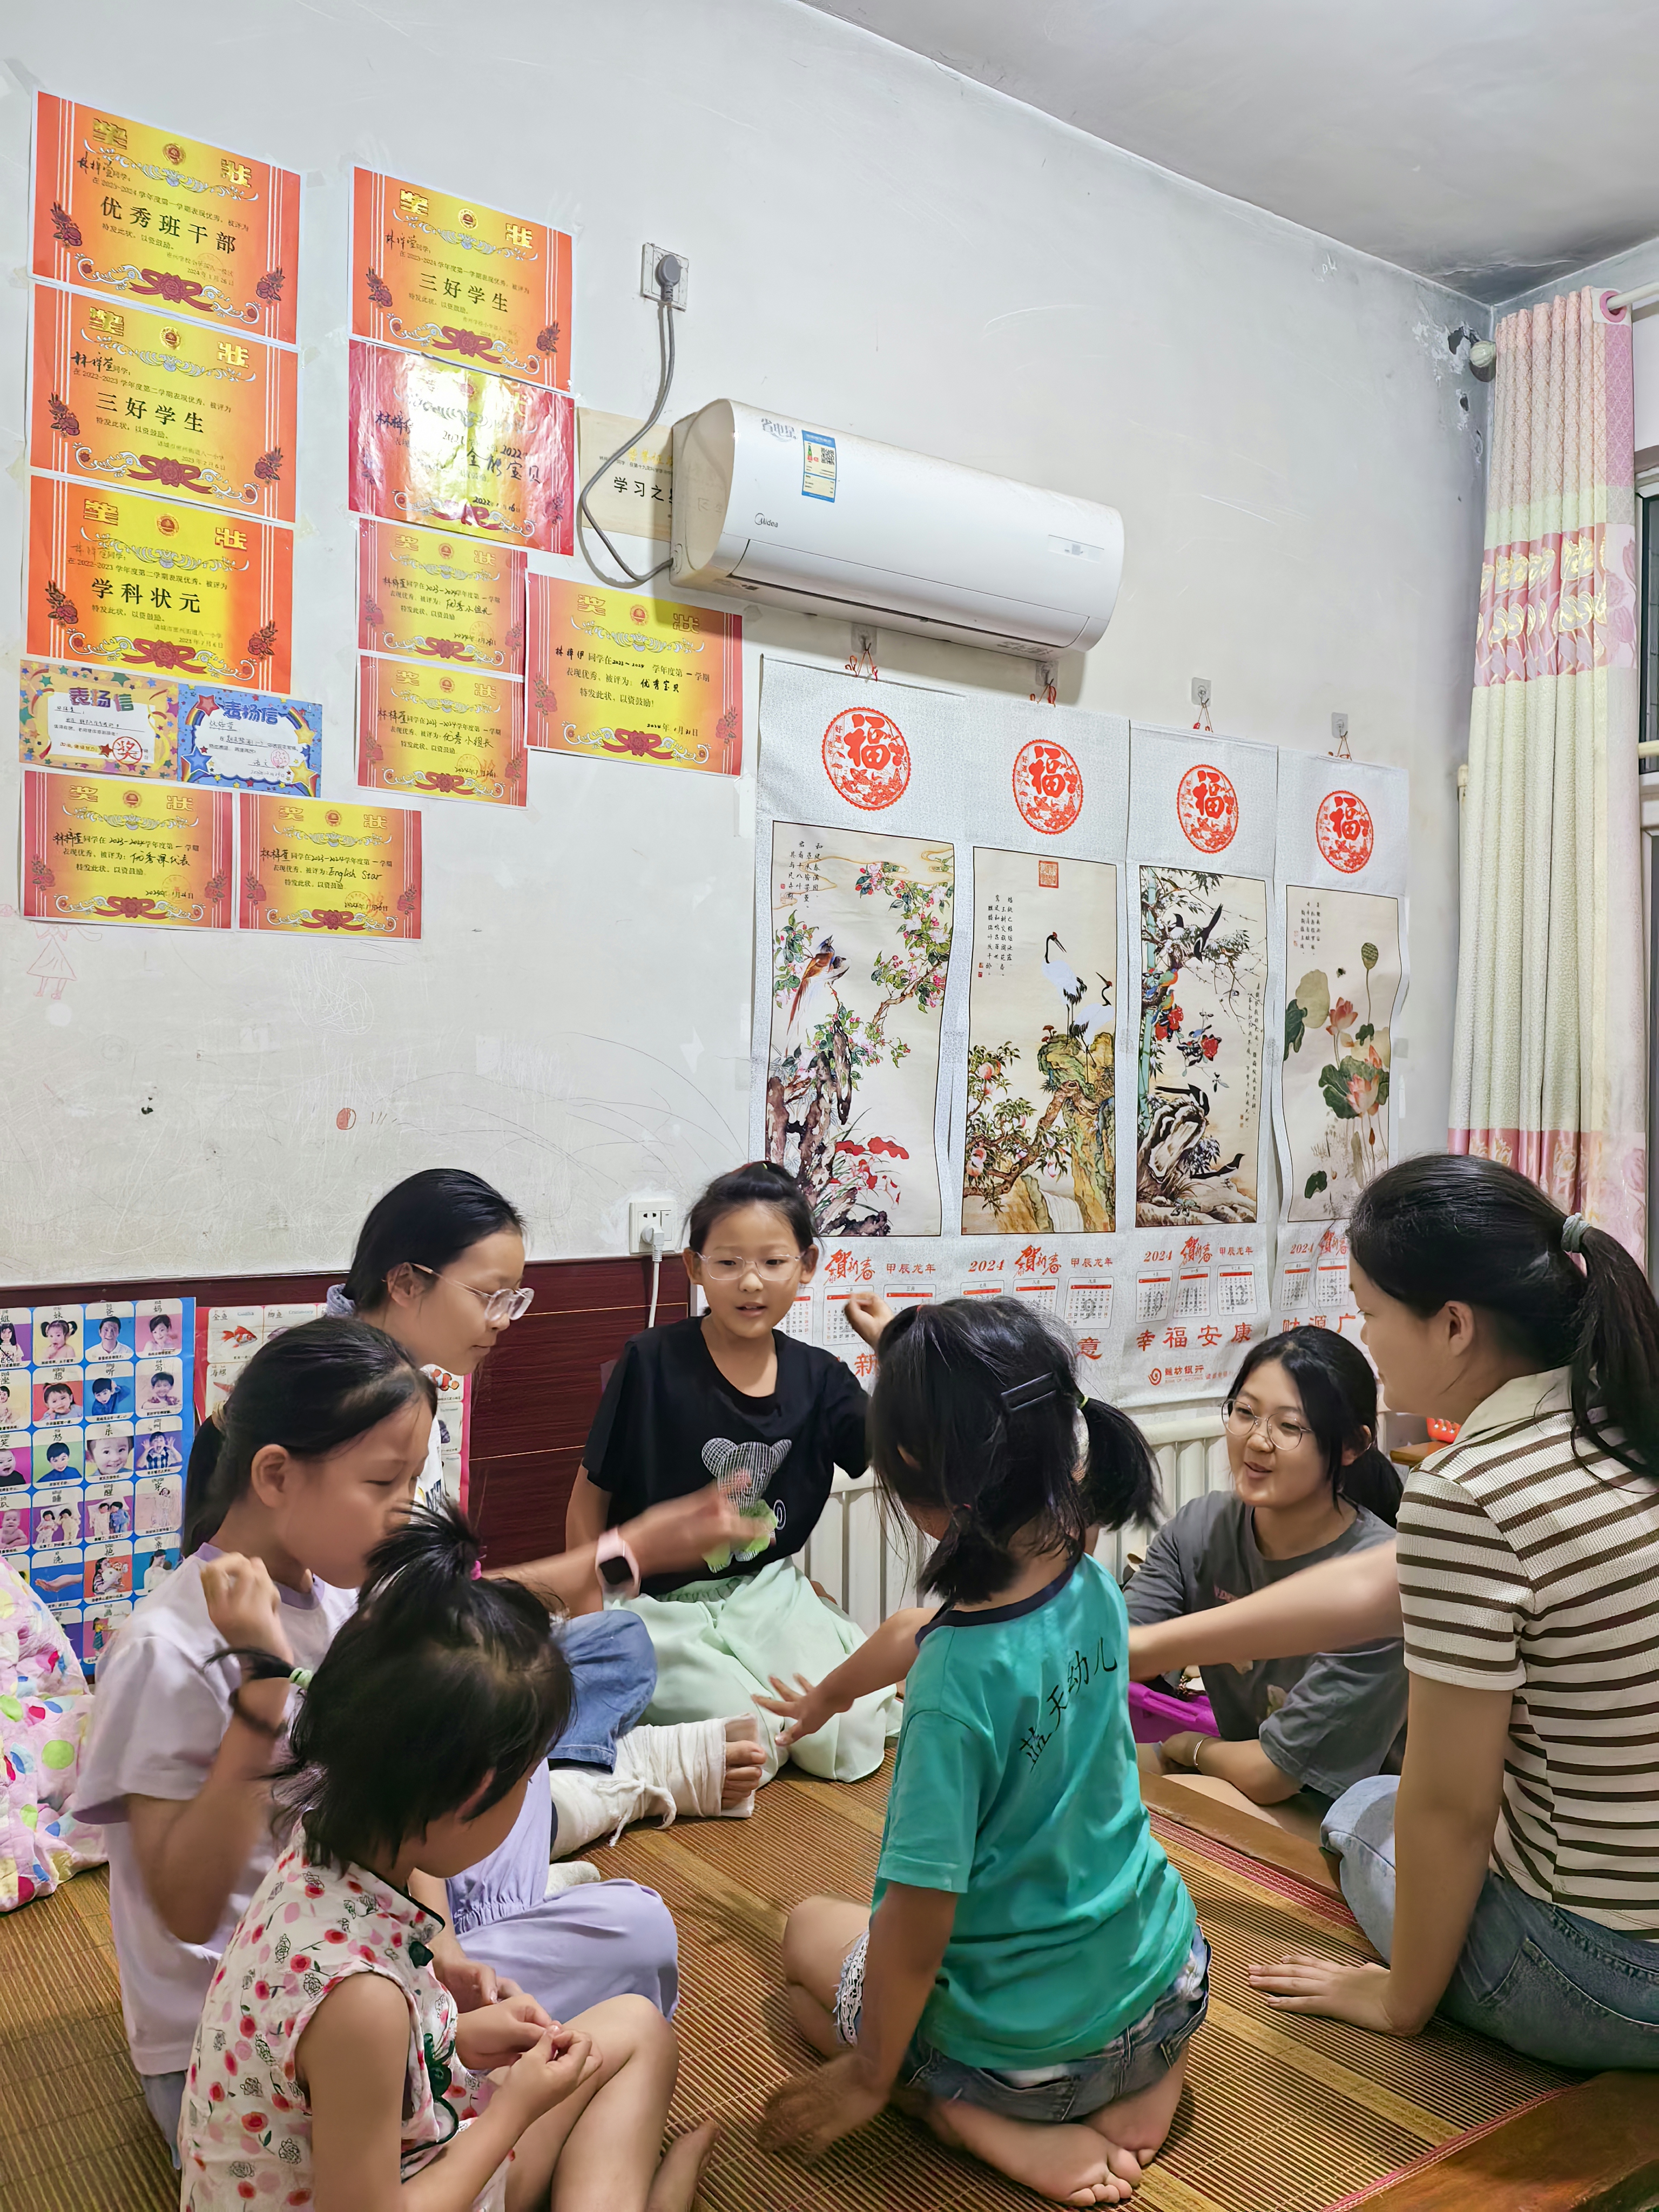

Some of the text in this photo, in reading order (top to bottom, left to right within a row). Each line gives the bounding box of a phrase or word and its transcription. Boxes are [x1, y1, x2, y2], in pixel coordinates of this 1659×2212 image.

[101, 196, 236, 254] 优秀班干部
[419, 273, 508, 313] 三好学生
[96, 392, 204, 433] 三好学生
[755, 512, 778, 528] Midea
[92, 577, 200, 613] 学科状元
[69, 687, 133, 712] 表扬信
[640, 678, 679, 693] 优秀宝贝
[222, 701, 278, 725] 表扬信
[844, 714, 891, 771] 福
[1029, 745, 1065, 797] 福
[1192, 770, 1225, 819] 福
[1330, 796, 1360, 840] 福
[329, 867, 356, 882] English
[362, 870, 383, 880] Star
[887, 1264, 936, 1274] 甲辰龙年
[968, 1260, 1004, 1272] 2024
[1071, 1258, 1113, 1267] 甲辰龙年
[1144, 1250, 1172, 1263] 2024
[1136, 1322, 1252, 1351] 幸福安康
